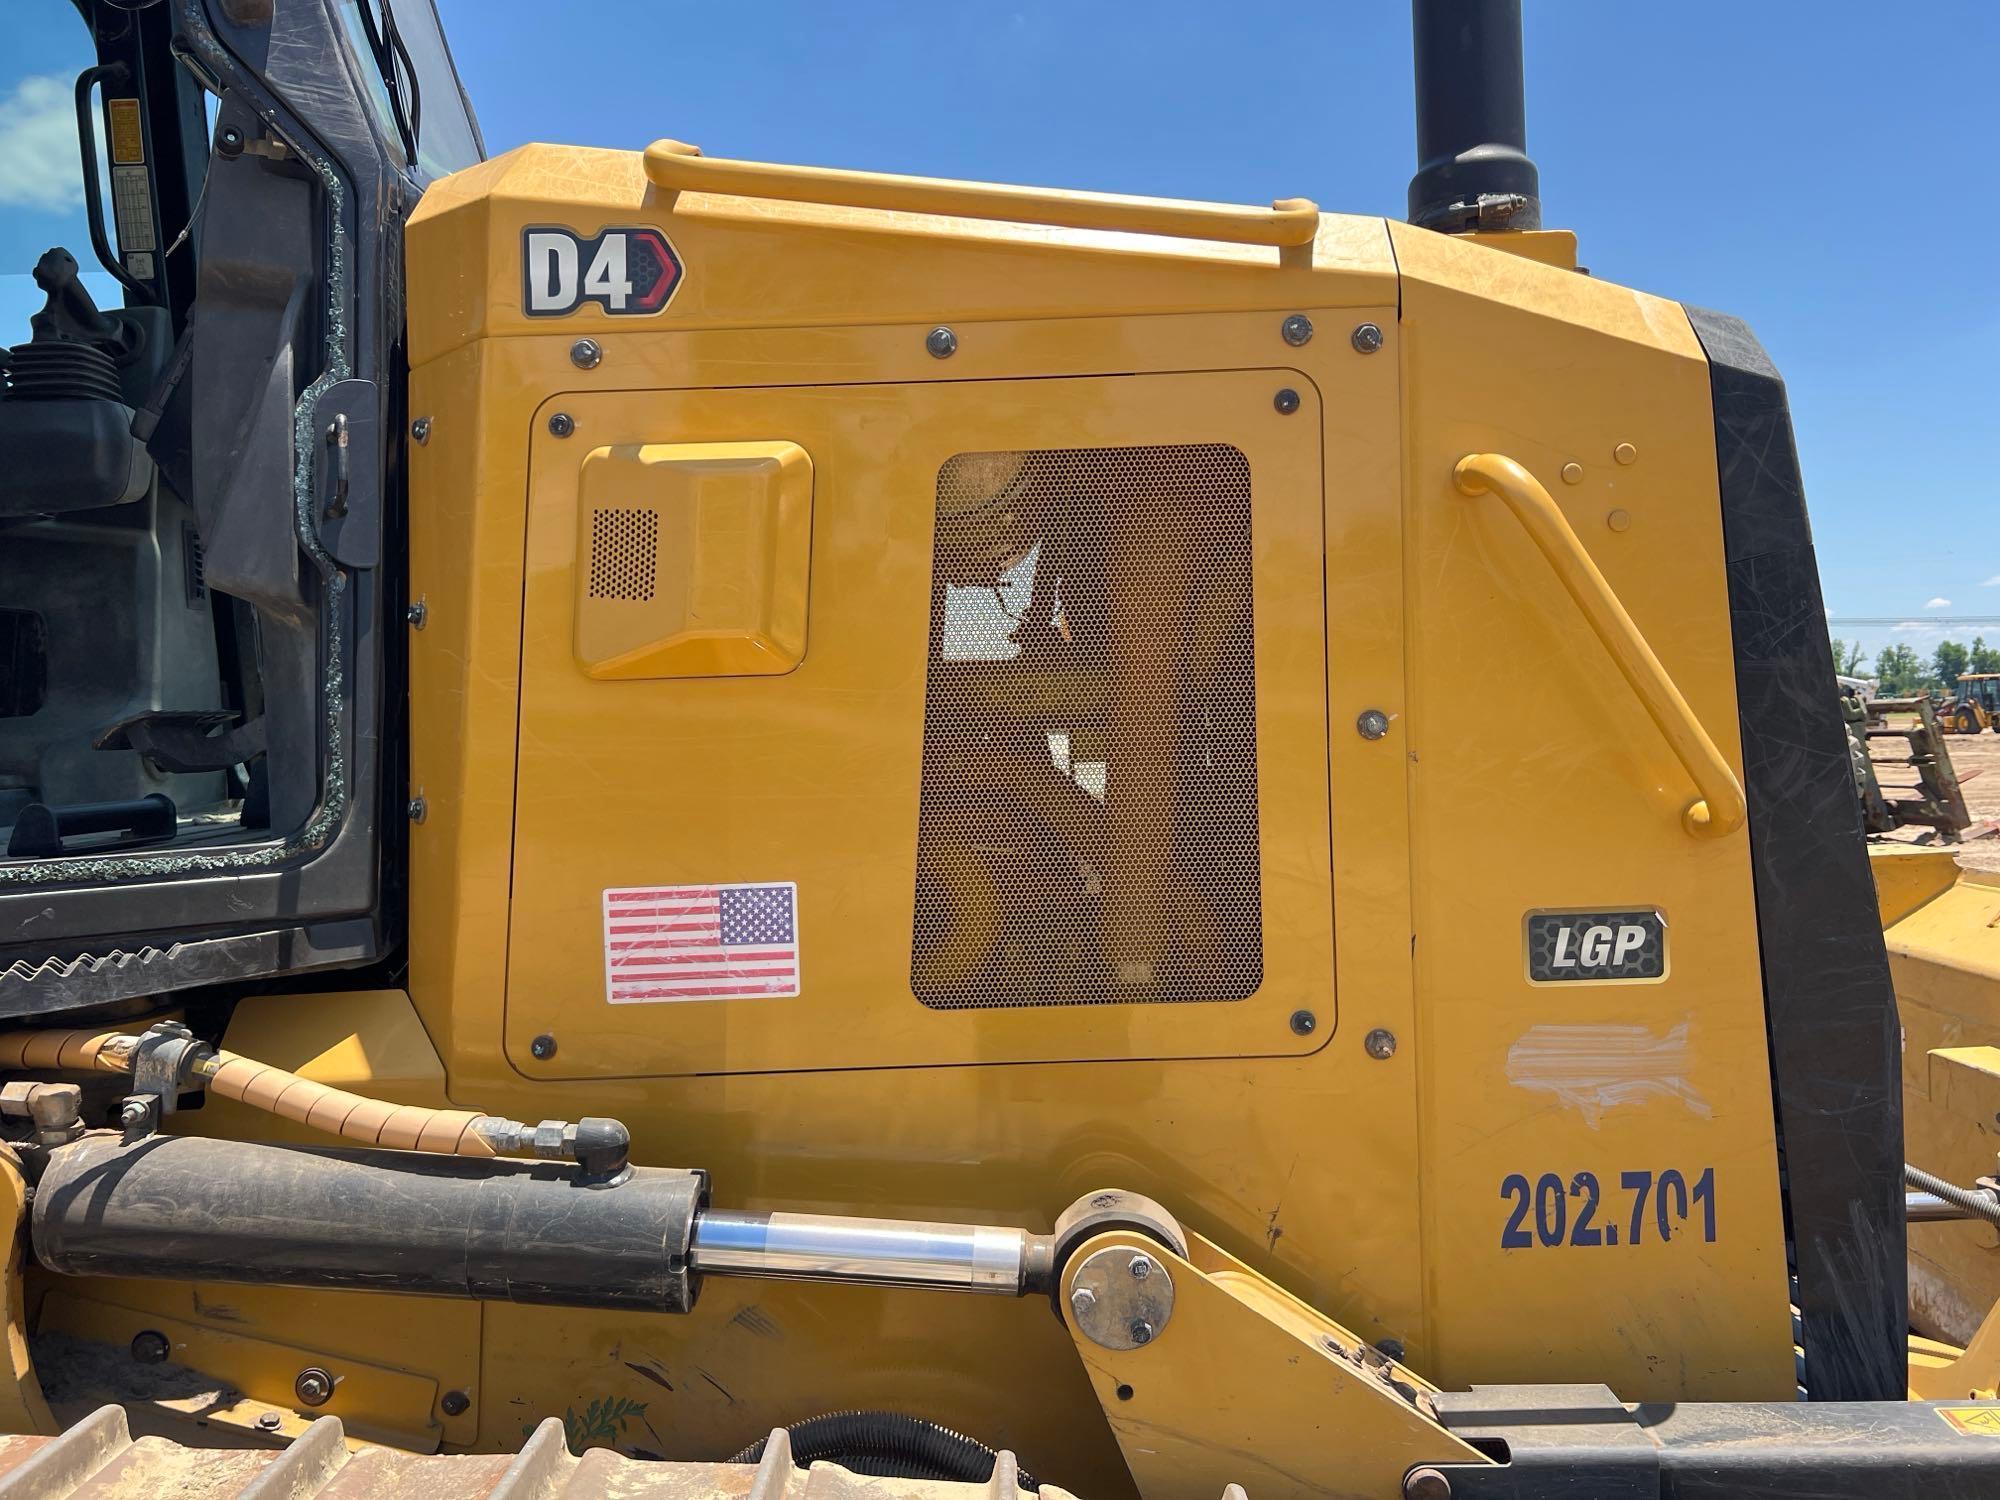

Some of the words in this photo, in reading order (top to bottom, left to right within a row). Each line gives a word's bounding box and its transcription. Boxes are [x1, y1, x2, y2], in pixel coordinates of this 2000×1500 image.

[528, 233, 633, 310] D4
[1552, 925, 1647, 968] LGP
[1500, 1167, 1716, 1248] 202.701
